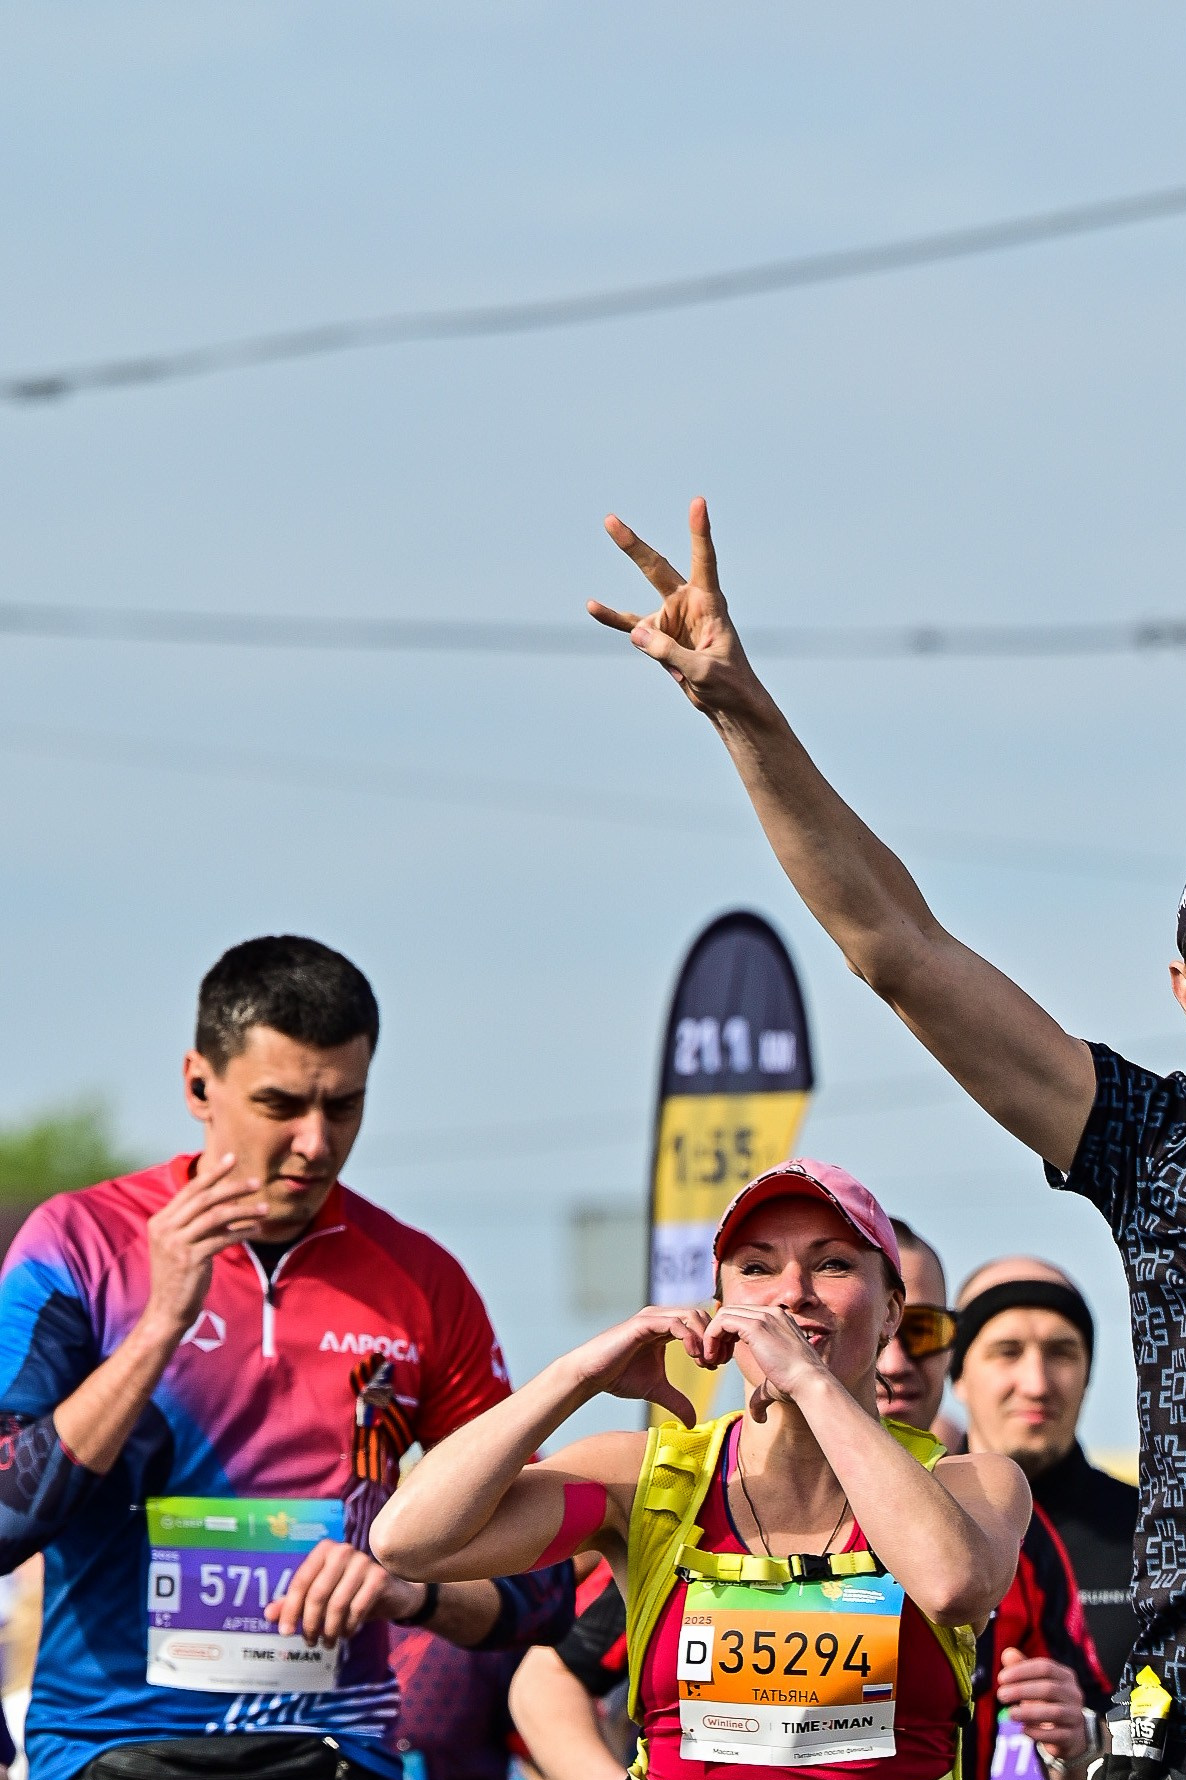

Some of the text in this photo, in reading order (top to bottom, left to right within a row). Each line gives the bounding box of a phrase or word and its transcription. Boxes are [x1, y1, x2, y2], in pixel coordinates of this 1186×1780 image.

[155, 1576, 175, 1597] D
[684, 1616, 712, 1625] 2025
[686, 1629, 872, 1678] D 35294
[751, 1688, 820, 1704] ТАТЬЯНА
[707, 1719, 744, 1729] Winline
